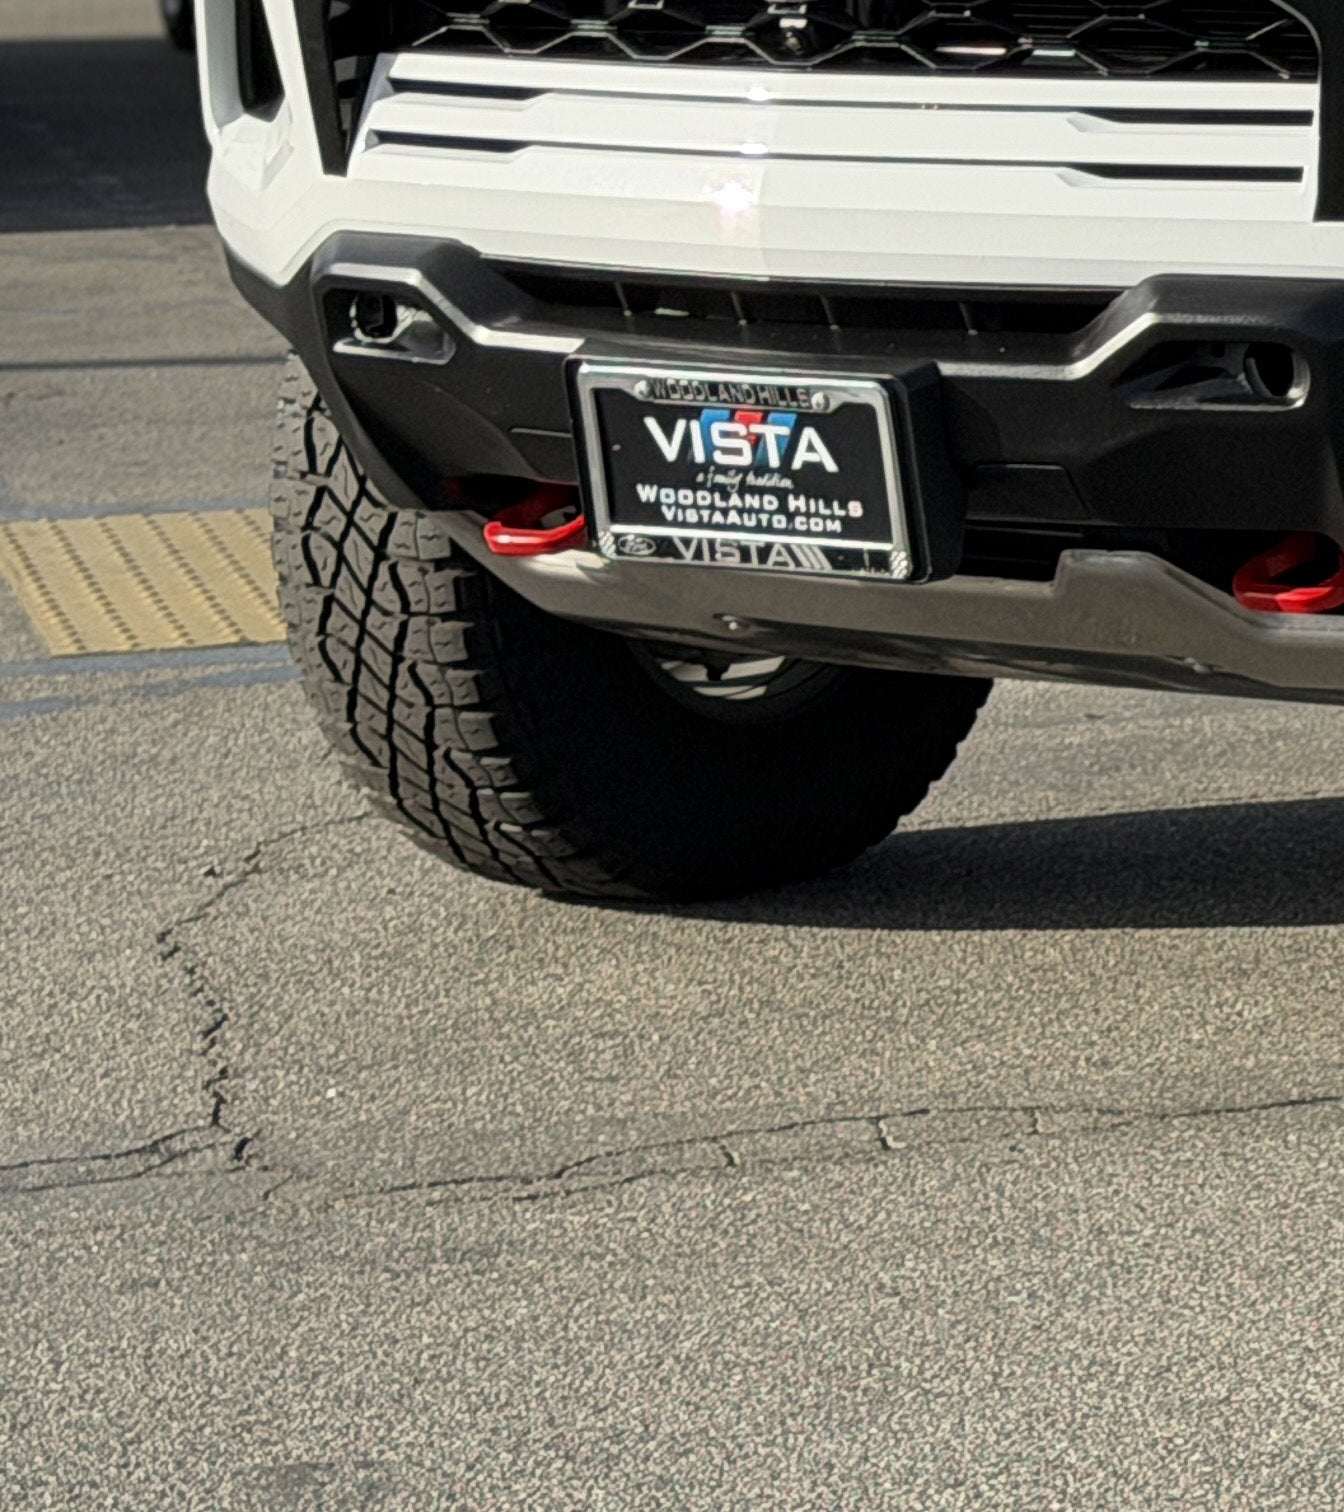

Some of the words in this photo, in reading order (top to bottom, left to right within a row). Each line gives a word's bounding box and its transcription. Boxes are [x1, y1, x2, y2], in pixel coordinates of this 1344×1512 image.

[651, 377, 757, 404] WOODLAND
[757, 385, 811, 408] HILLS
[643, 416, 840, 473] VISTA
[636, 483, 779, 512] WOODLAND
[788, 493, 864, 518] HILLS
[661, 505, 843, 534] VISTAAUTO.COM
[672, 536, 797, 569] VISTA
